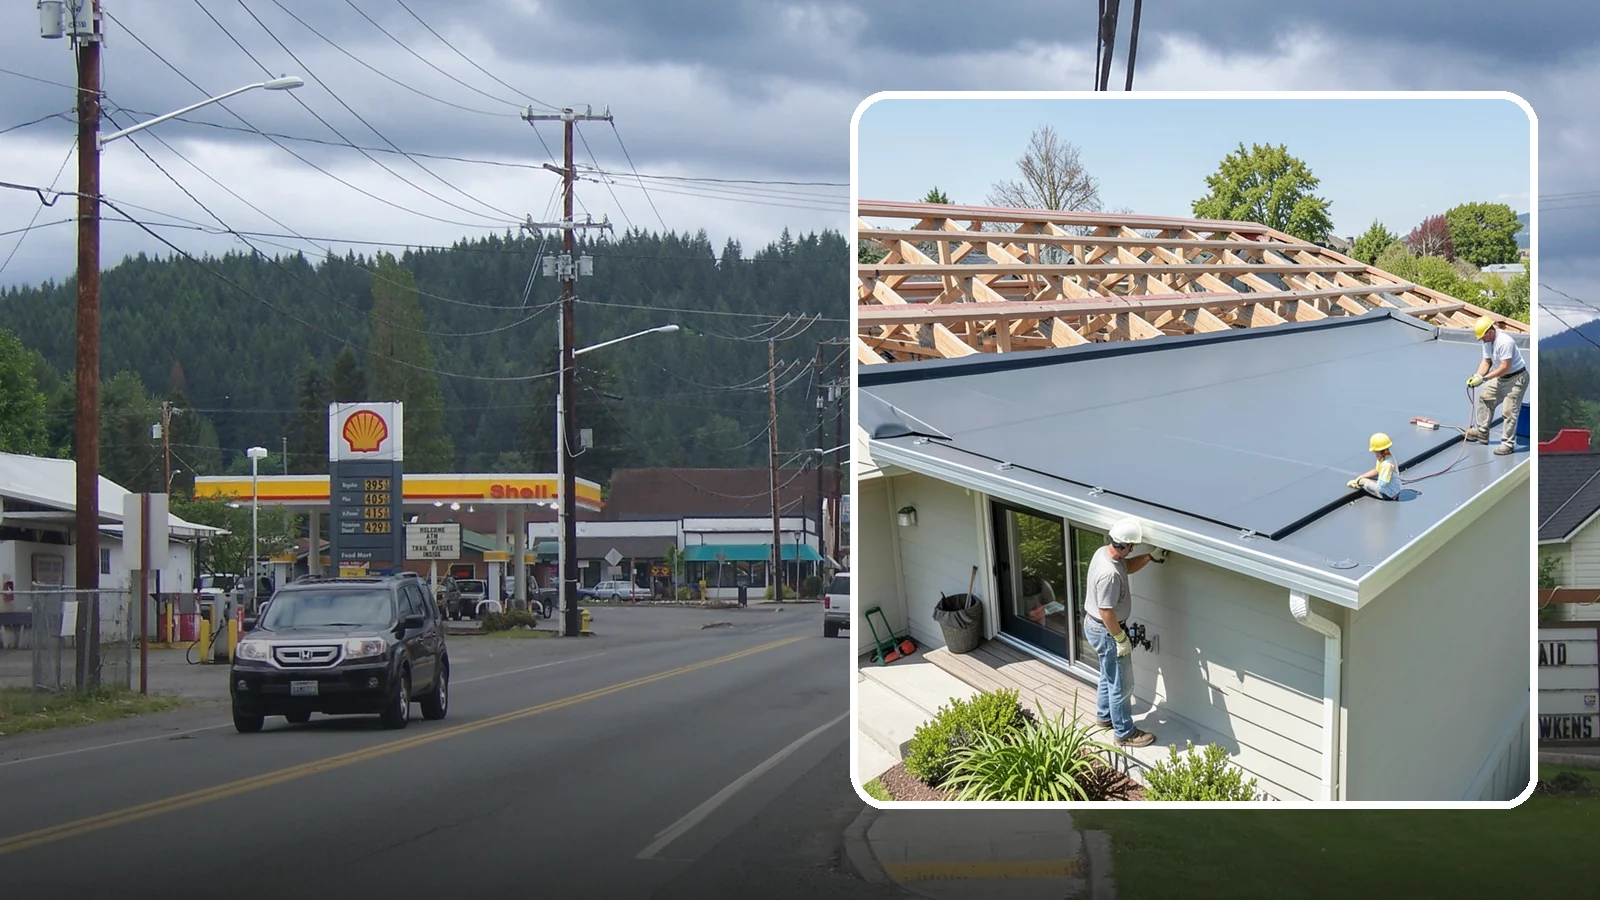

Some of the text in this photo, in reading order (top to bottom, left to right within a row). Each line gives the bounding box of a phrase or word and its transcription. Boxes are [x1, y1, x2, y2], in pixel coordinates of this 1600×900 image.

[366, 480, 384, 490] 395
[490, 484, 546, 498] Shell
[366, 494, 384, 504] 405
[366, 508, 384, 518] 415
[366, 522, 384, 532] 429
[1538, 642, 1566, 666] AID
[1538, 716, 1592, 739] WKENS
